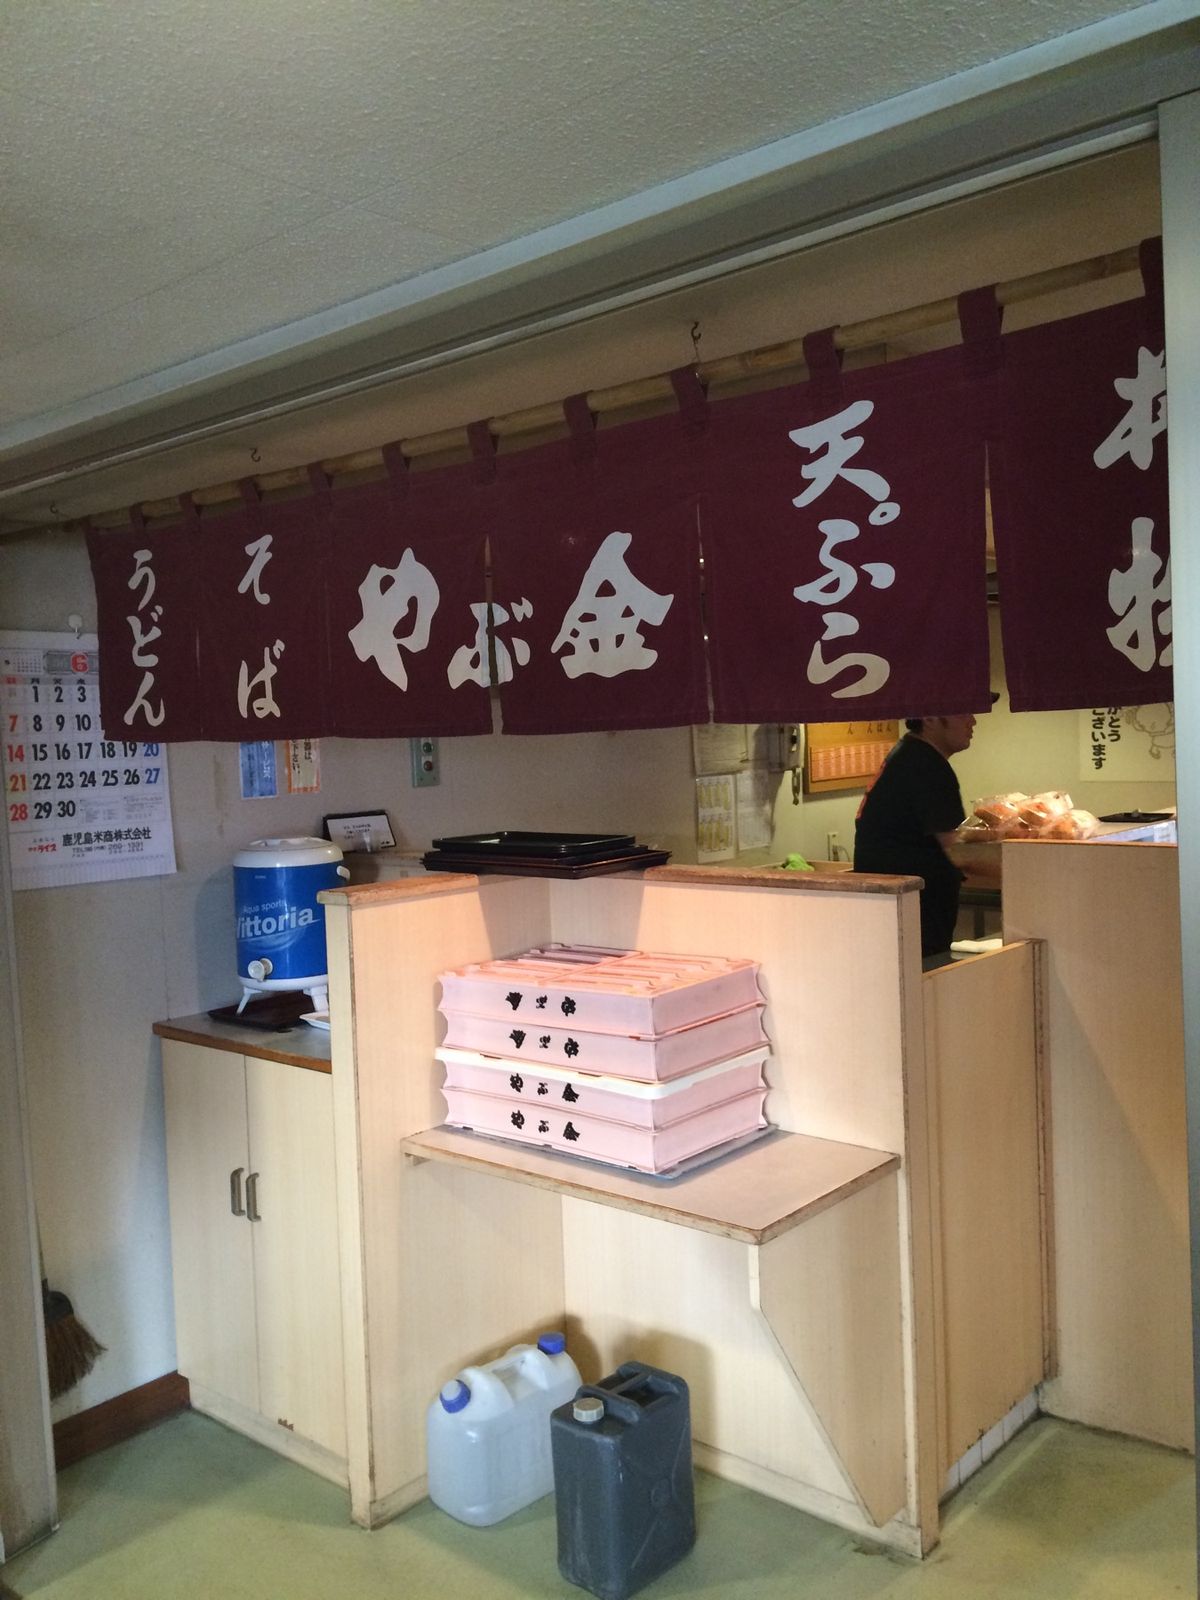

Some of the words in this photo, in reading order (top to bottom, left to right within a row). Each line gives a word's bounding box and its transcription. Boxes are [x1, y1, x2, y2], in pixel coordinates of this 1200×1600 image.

[788, 400, 901, 699] 天ぷら
[348, 531, 674, 692] やぶ金
[237, 534, 285, 719] そば
[123, 549, 165, 727] うどん
[71, 653, 89, 673] 6
[32, 686, 39, 702] 1
[55, 686, 64, 702] 2
[78, 686, 86, 702] 3
[9, 714, 18, 732] 7
[33, 714, 42, 732] 8
[56, 714, 65, 731] 9
[75, 714, 91, 731] 10
[7, 744, 25, 762] 14
[32, 744, 48, 761] 15
[55, 743, 70, 760] 16
[78, 742, 92, 759] 17
[100, 742, 116, 758] 18
[123, 741, 137, 757] 19
[143, 742, 159, 757] 20
[10, 774, 27, 792] 21
[33, 773, 51, 790] 22
[57, 772, 74, 789] 23
[80, 771, 96, 788] 24
[102, 770, 119, 787] 25
[124, 769, 140, 785] 26
[145, 768, 160, 784] 27
[10, 803, 28, 821] 28
[34, 802, 52, 819] 29
[57, 801, 76, 817] 30
